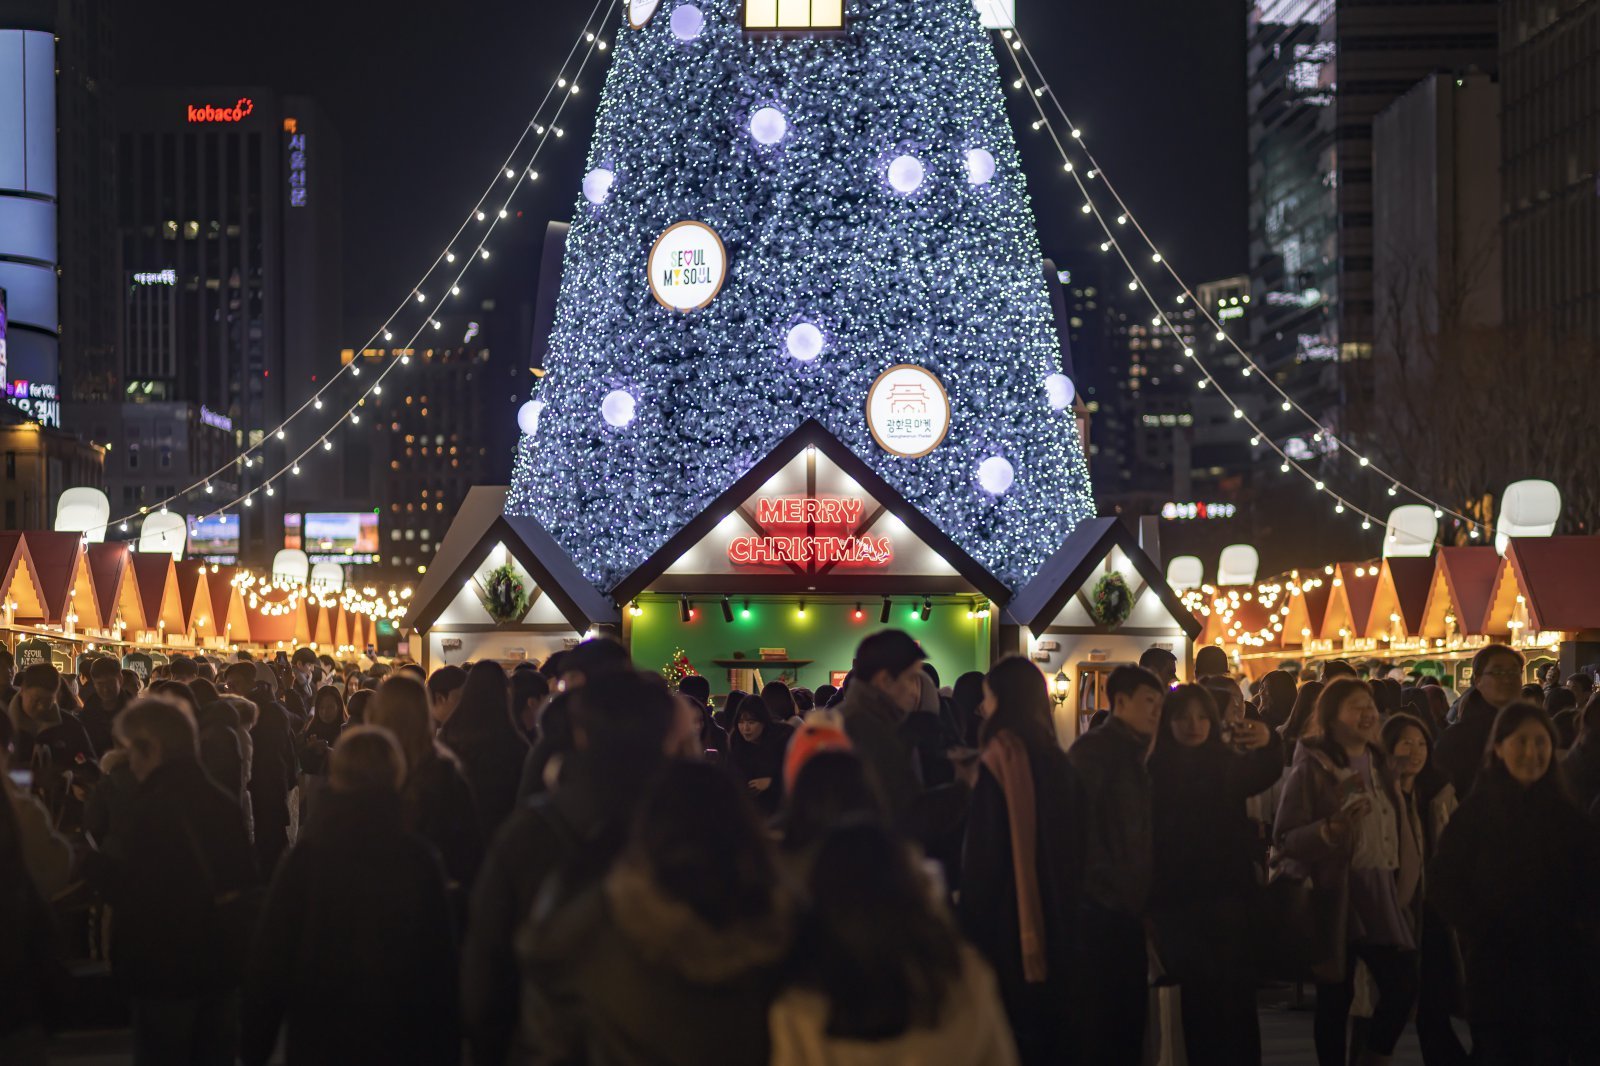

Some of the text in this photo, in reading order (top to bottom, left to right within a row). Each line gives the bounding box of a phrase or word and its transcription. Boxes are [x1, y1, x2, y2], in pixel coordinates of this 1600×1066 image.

[187, 104, 243, 122] kobaco
[683, 267, 712, 285] SOUL
[887, 419, 912, 433] 광화문
[759, 498, 862, 523] MERRY
[729, 536, 892, 563] CHRISTMAS
